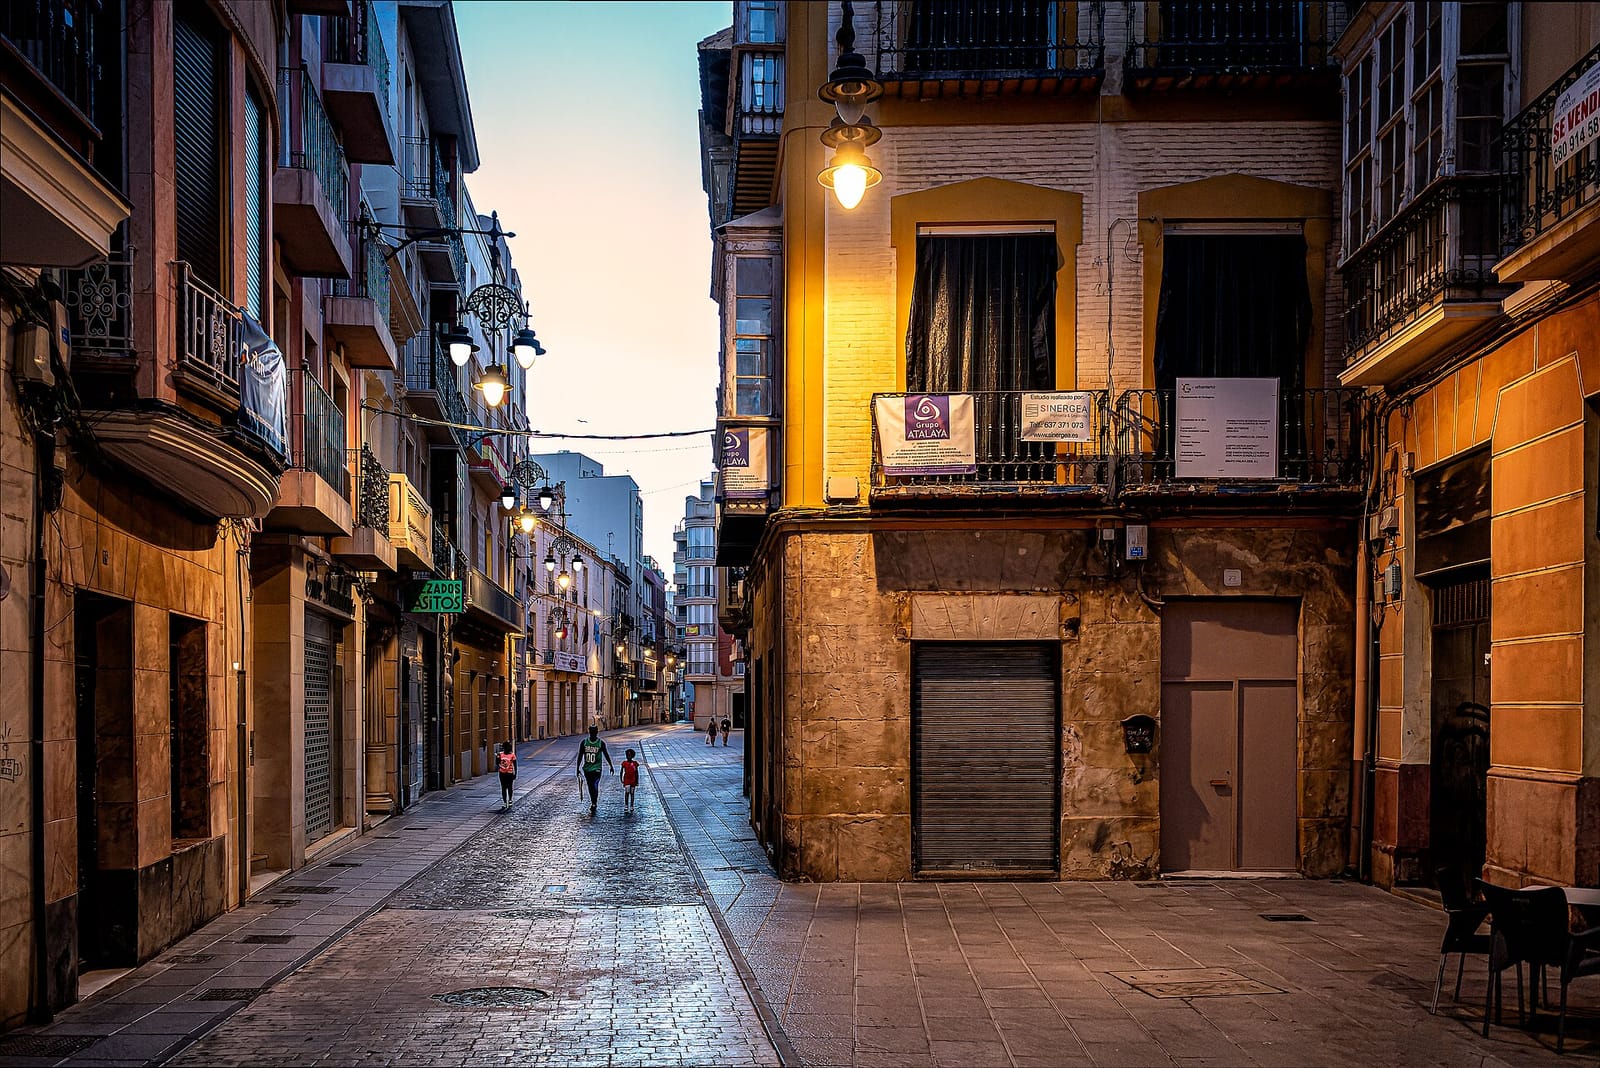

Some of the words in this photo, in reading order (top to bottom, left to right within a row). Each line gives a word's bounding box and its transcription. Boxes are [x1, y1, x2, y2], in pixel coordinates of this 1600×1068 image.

[1553, 116, 1566, 144] SE
[1567, 88, 1600, 131] VEND
[1553, 141, 1567, 165] 680
[1569, 126, 1585, 151] 914
[1588, 116, 1600, 137] 58
[1040, 404, 1088, 413] SINERGEA
[916, 422, 939, 430] Grupo
[907, 429, 948, 439] ATALAYA
[586, 753, 596, 763] 00
